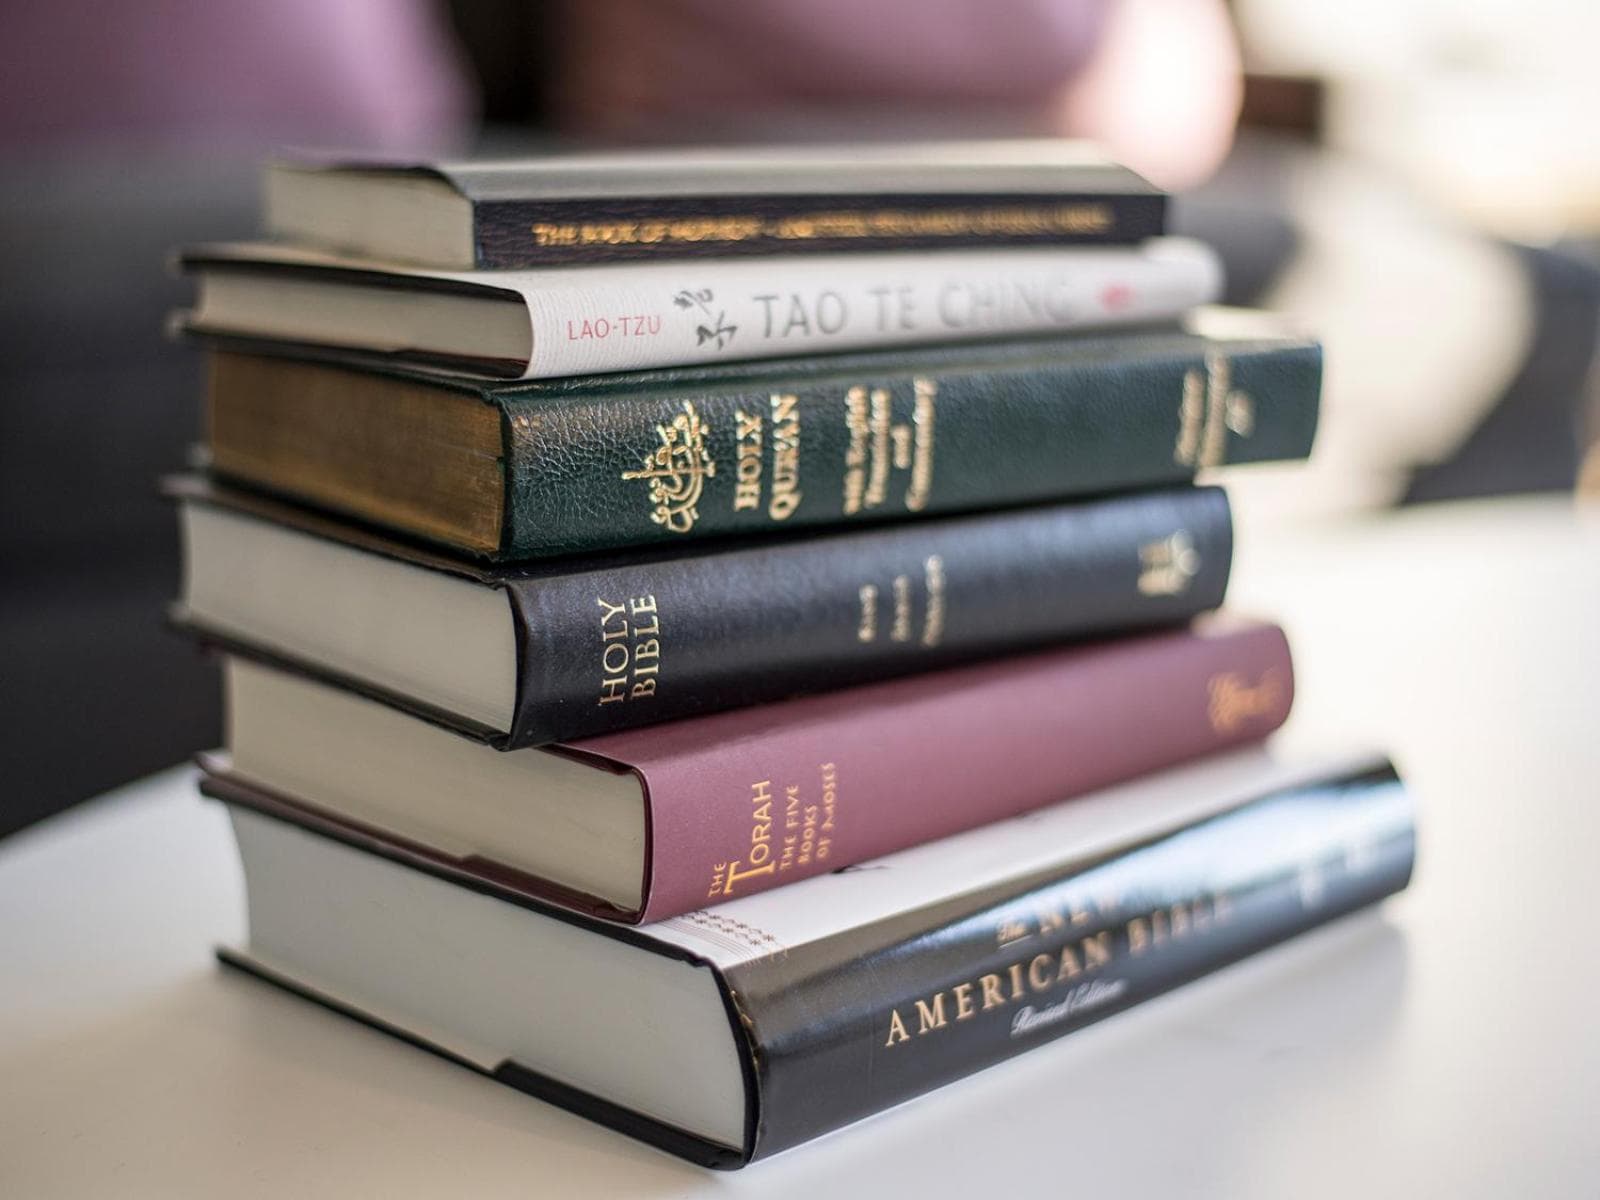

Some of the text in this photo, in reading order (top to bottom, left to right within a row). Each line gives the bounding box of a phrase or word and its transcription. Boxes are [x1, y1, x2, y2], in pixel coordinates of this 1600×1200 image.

[567, 315, 661, 341] LAO-TZU
[753, 275, 1077, 338] TAO TE CHING
[734, 409, 763, 512] HOLY
[597, 596, 630, 707] HOLY
[630, 594, 660, 700] BIBLE
[779, 784, 800, 871] THE FIVE
[797, 804, 818, 865] BOOKS
[815, 837, 831, 860] OF
[708, 862, 728, 898] THE
[885, 930, 1113, 1048] AMERICAN
